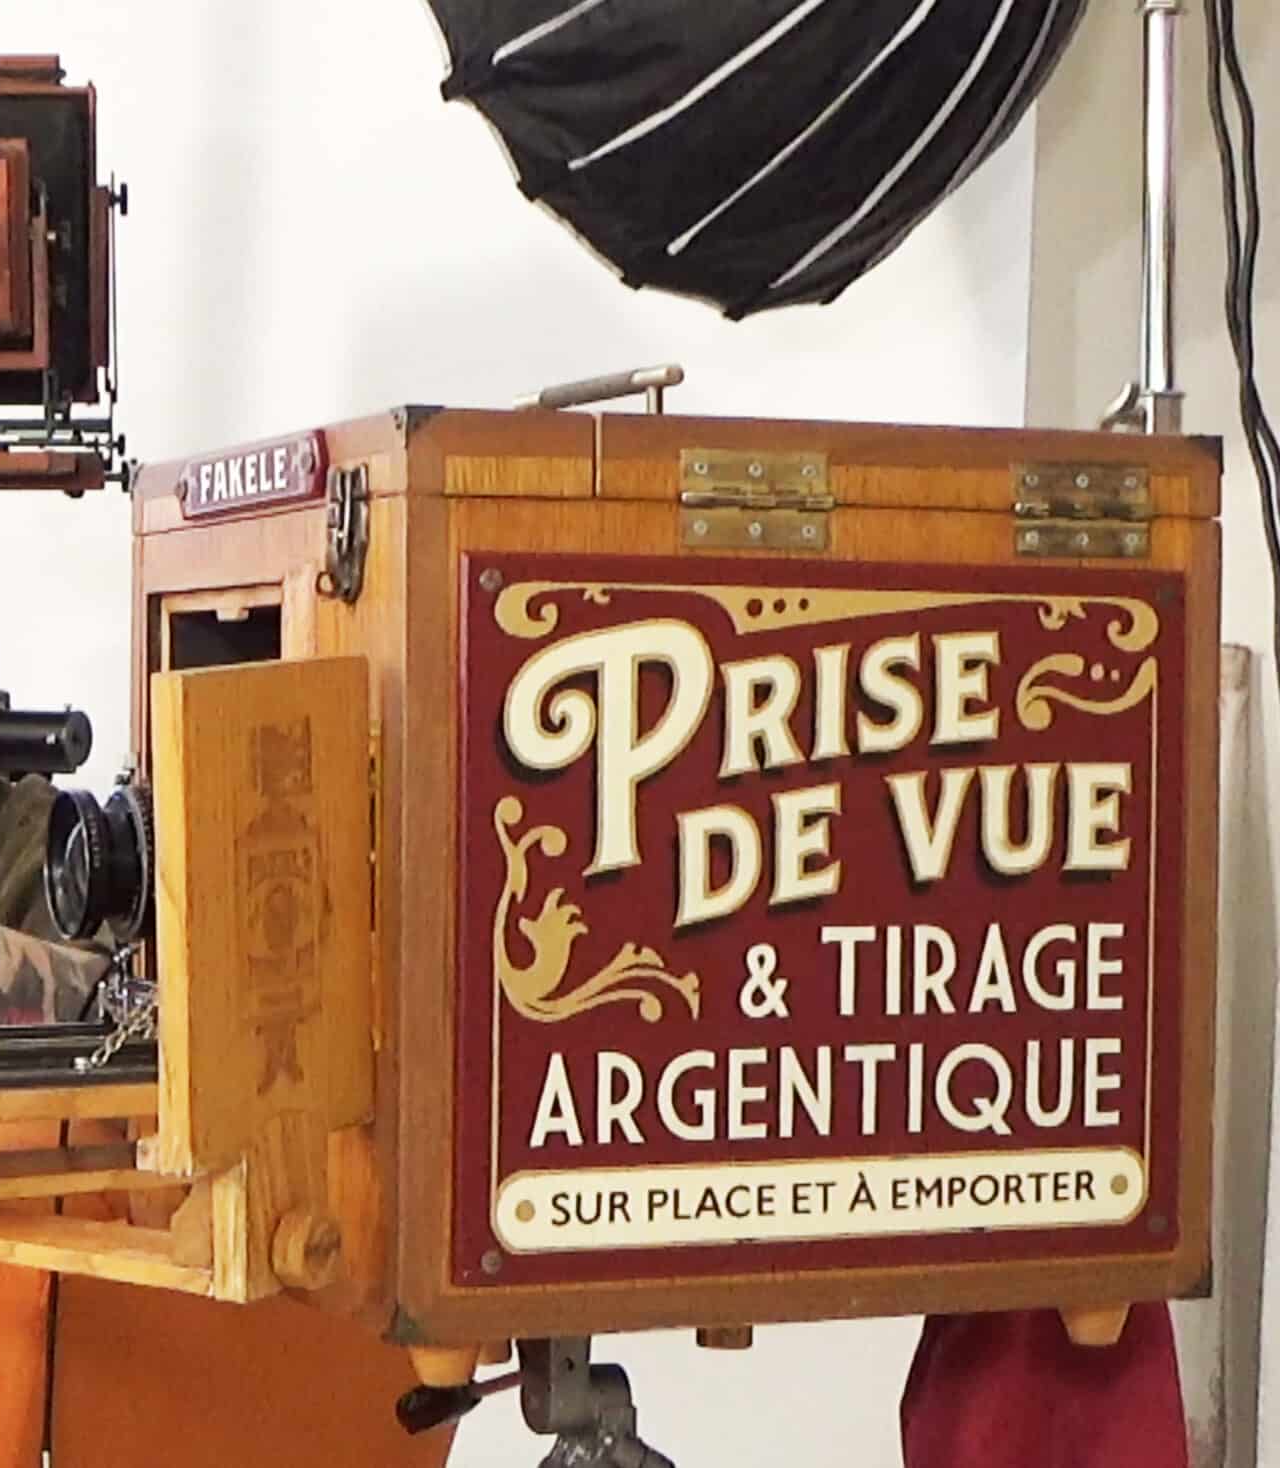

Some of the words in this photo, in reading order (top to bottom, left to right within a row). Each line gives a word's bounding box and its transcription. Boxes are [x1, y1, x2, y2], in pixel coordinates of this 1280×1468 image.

[201, 448, 287, 504] FAKELE
[504, 618, 1000, 876] PRISE
[673, 785, 841, 928] DE
[886, 762, 1132, 881] VUE
[739, 943, 789, 1019] &
[821, 923, 1125, 1017] TIRAGE
[528, 1038, 1122, 1149] ARGENTIQUE
[550, 1191, 632, 1226] SUR
[647, 1183, 776, 1221] PLACE
[791, 1181, 837, 1214] ET
[849, 1171, 877, 1212] À
[891, 1170, 1096, 1209] EMPORTER
